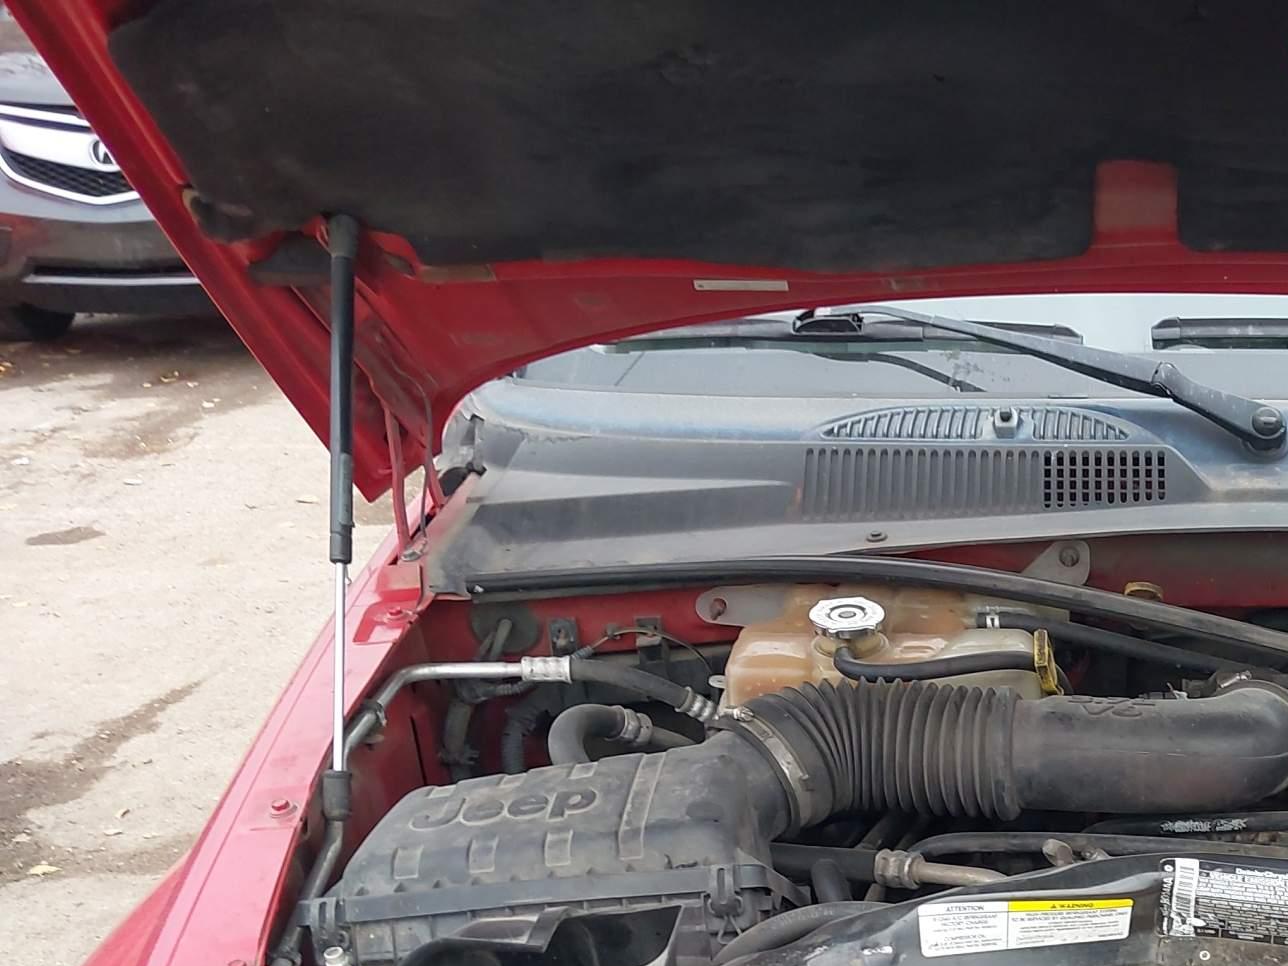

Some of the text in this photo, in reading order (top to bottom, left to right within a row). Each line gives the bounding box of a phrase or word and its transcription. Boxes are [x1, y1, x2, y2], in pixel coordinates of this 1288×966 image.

[407, 786, 599, 833] Jeep
[1209, 871, 1243, 883] VEHICLE
[1244, 875, 1285, 887] EMISSION
